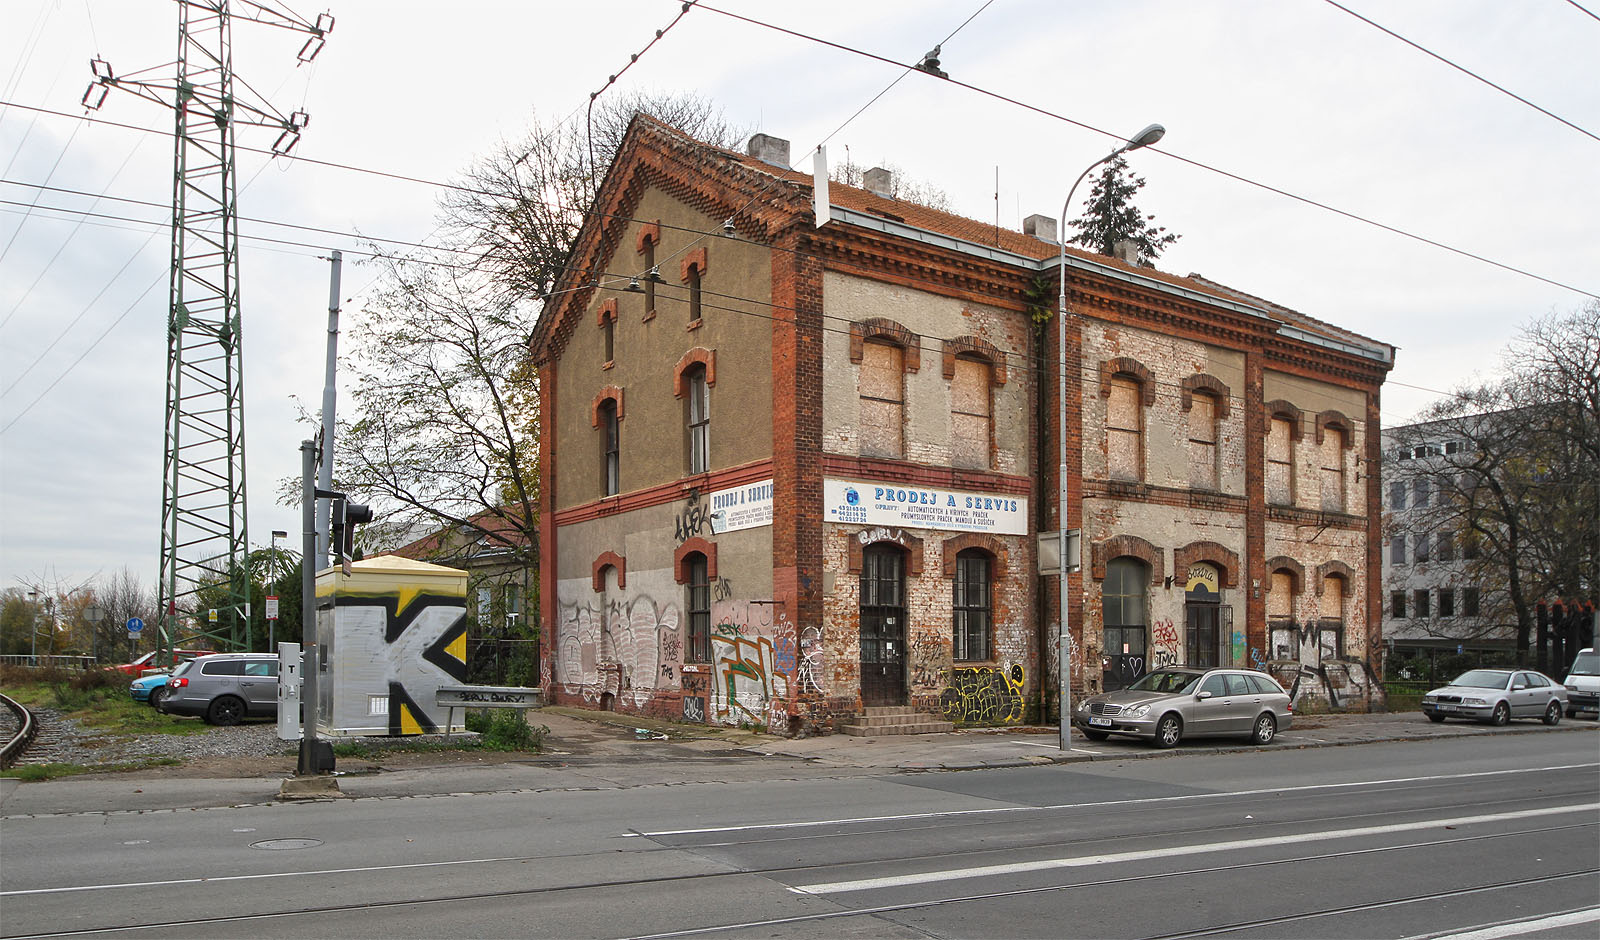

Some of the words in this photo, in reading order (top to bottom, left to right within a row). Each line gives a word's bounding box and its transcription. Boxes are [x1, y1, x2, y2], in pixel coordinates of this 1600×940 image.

[741, 490, 745, 504] A
[875, 488, 937, 505] PRODEJ
[947, 494, 957, 507] A
[966, 496, 1017, 512] SERVIS
[288, 665, 295, 673] T
